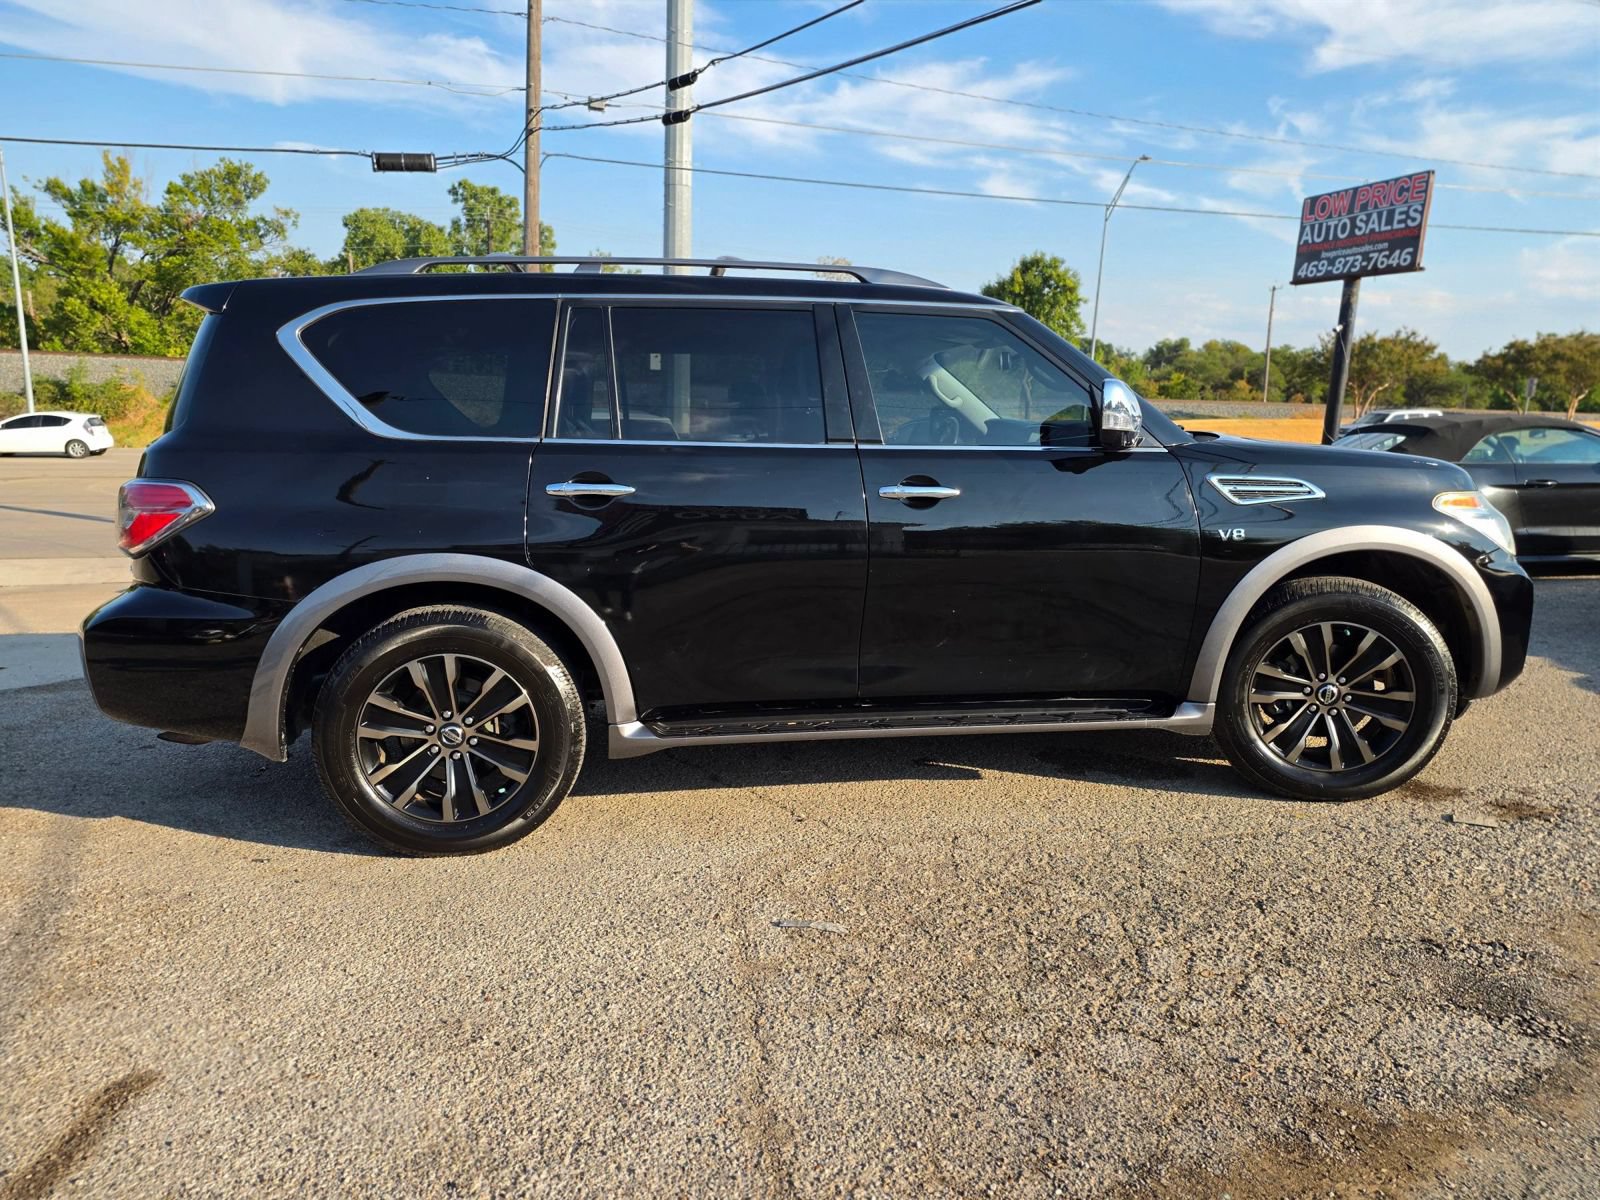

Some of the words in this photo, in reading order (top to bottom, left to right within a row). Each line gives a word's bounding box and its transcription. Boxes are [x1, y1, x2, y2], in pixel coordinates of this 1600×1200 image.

[1303, 190, 1353, 223] LOW
[1355, 173, 1429, 213] PRICE
[1299, 218, 1350, 245] AUTO
[1355, 204, 1423, 236] SALES
[1297, 248, 1414, 278] 469-873-7646
[1218, 528, 1246, 541] V8
